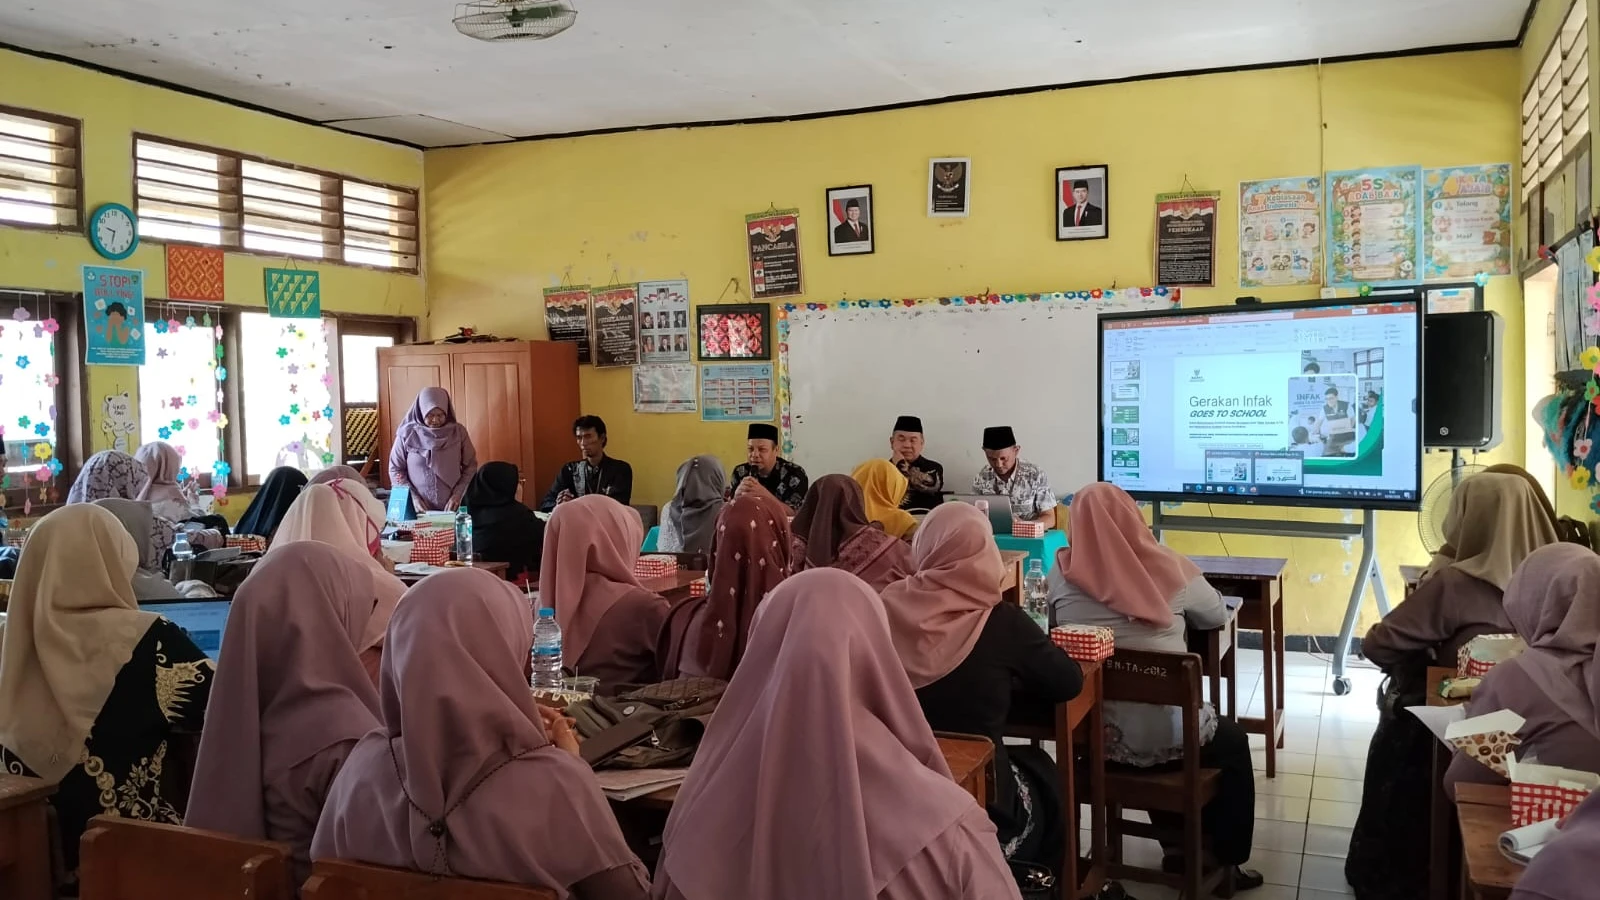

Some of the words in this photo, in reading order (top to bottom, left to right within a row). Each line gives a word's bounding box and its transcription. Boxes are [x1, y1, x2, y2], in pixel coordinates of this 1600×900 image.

[1362, 178, 1384, 191] 5S
[1376, 190, 1400, 199] BAK
[1456, 200, 1478, 208] Tolong
[1189, 395, 1240, 407] Gerakan
[1243, 394, 1273, 407] Infak
[1296, 393, 1321, 401] INFAK
[1190, 409, 1215, 418] GOES
[1216, 409, 1229, 418] TO
[1230, 409, 1267, 418] SCHOOL
